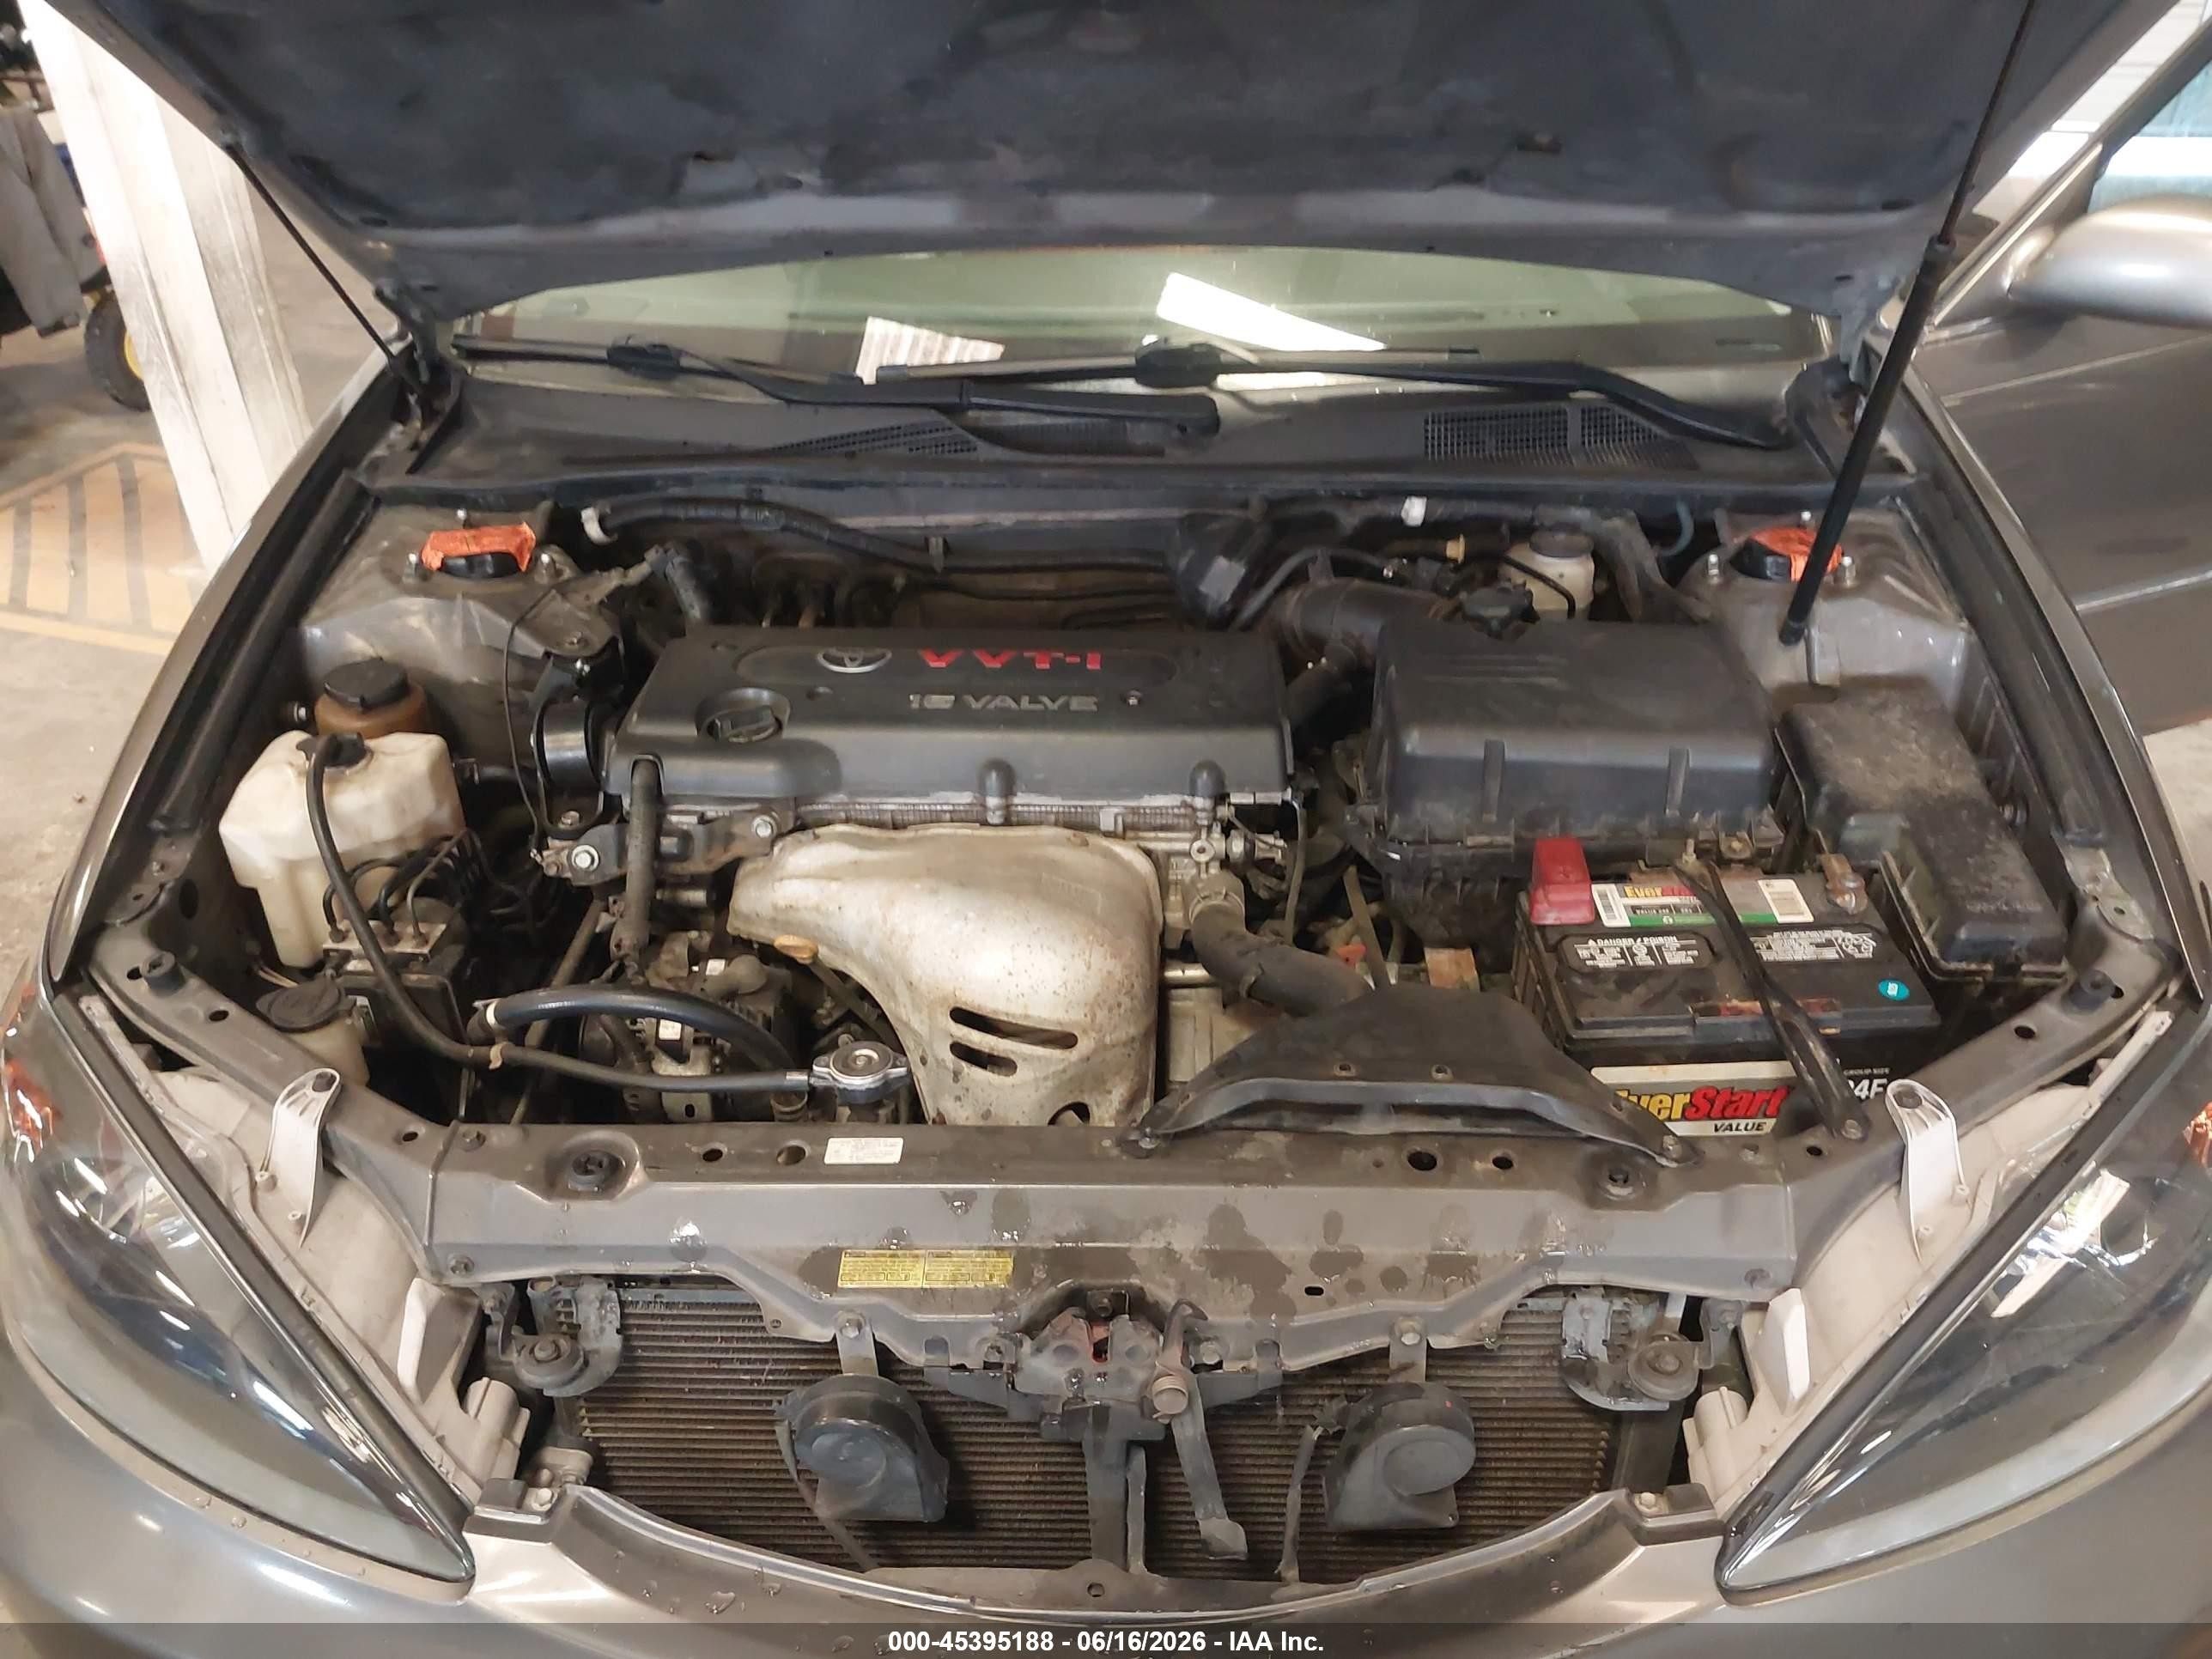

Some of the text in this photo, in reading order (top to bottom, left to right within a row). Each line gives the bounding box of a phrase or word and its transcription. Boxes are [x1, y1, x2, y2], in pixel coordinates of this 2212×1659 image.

[908, 694, 1098, 712] 16 VALVE
[1614, 1085, 1790, 1121] erStart
[1713, 1121, 1767, 1133] VALUE
